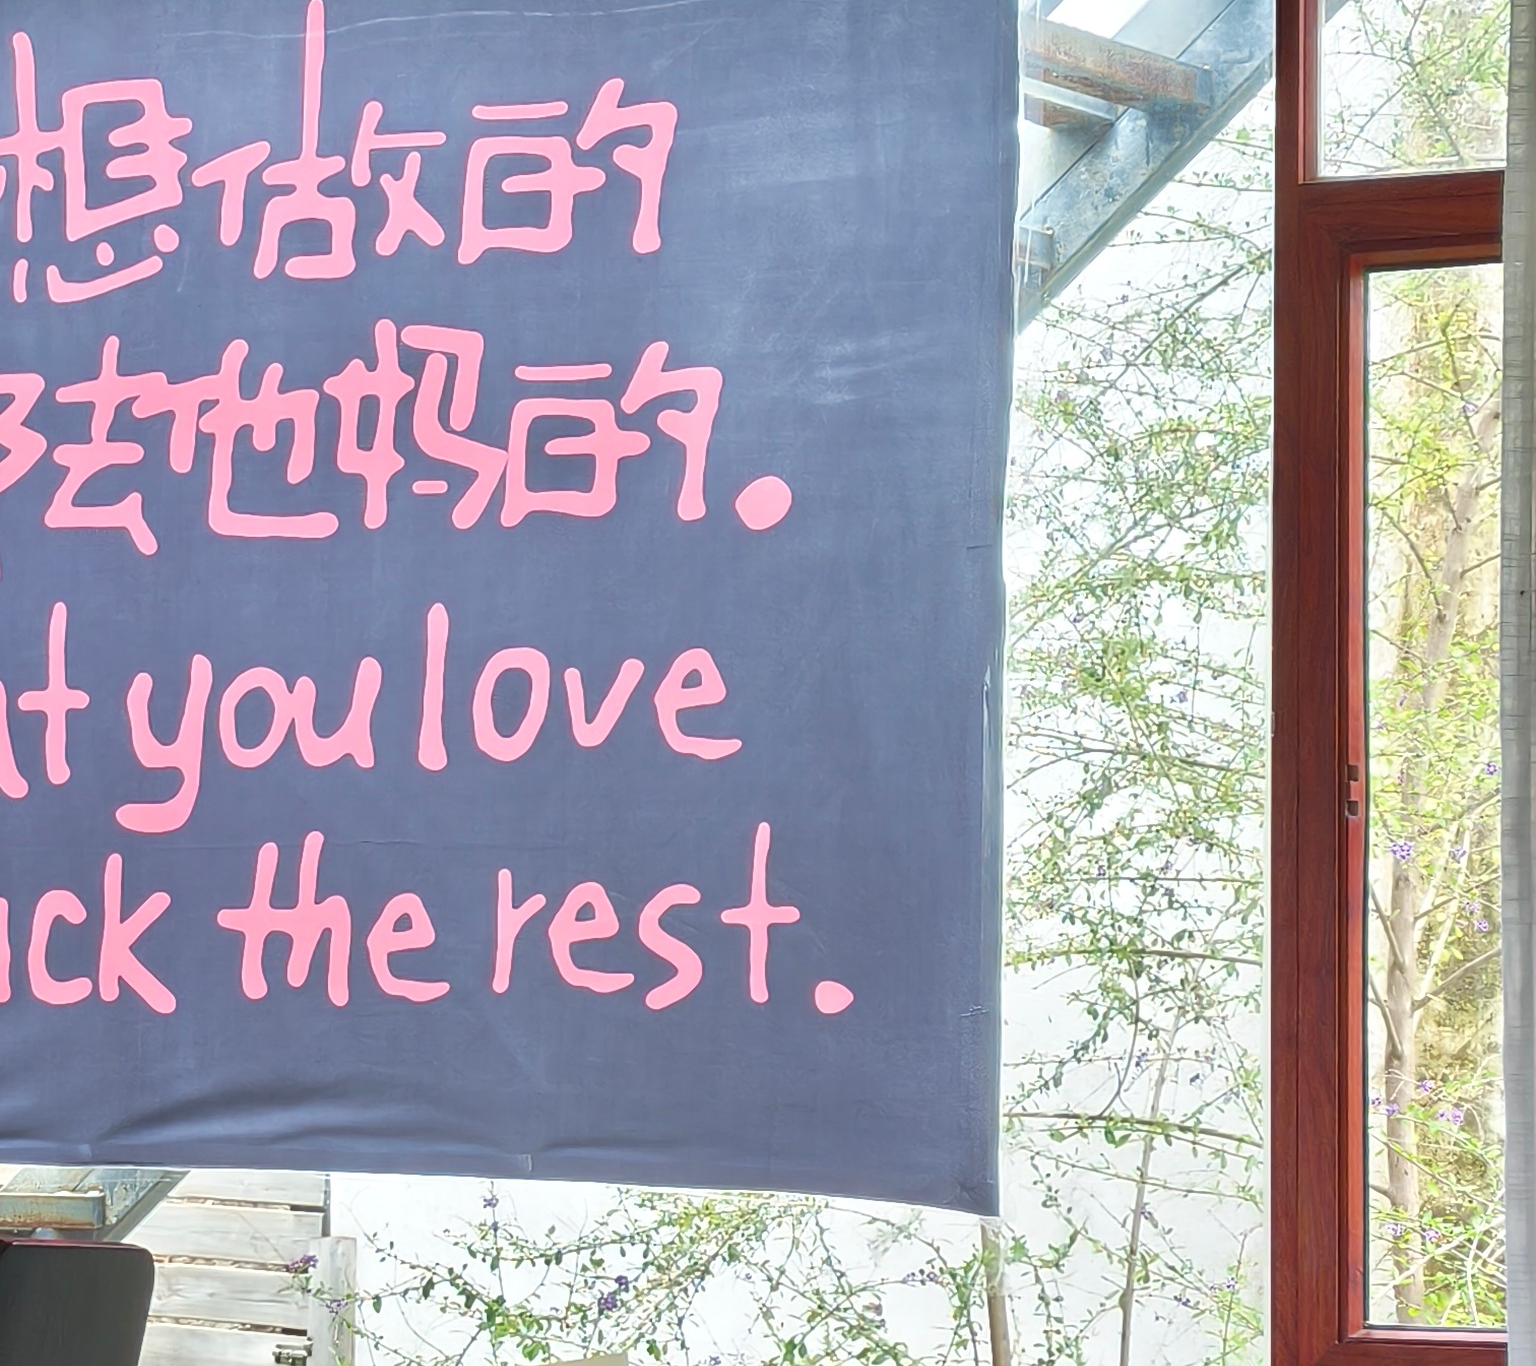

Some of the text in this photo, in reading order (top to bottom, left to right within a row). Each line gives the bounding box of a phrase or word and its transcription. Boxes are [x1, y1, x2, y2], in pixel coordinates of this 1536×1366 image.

[115, 656, 382, 835] you
[416, 604, 742, 773] love
[216, 832, 450, 1007] the
[491, 826, 853, 1014] rest.
